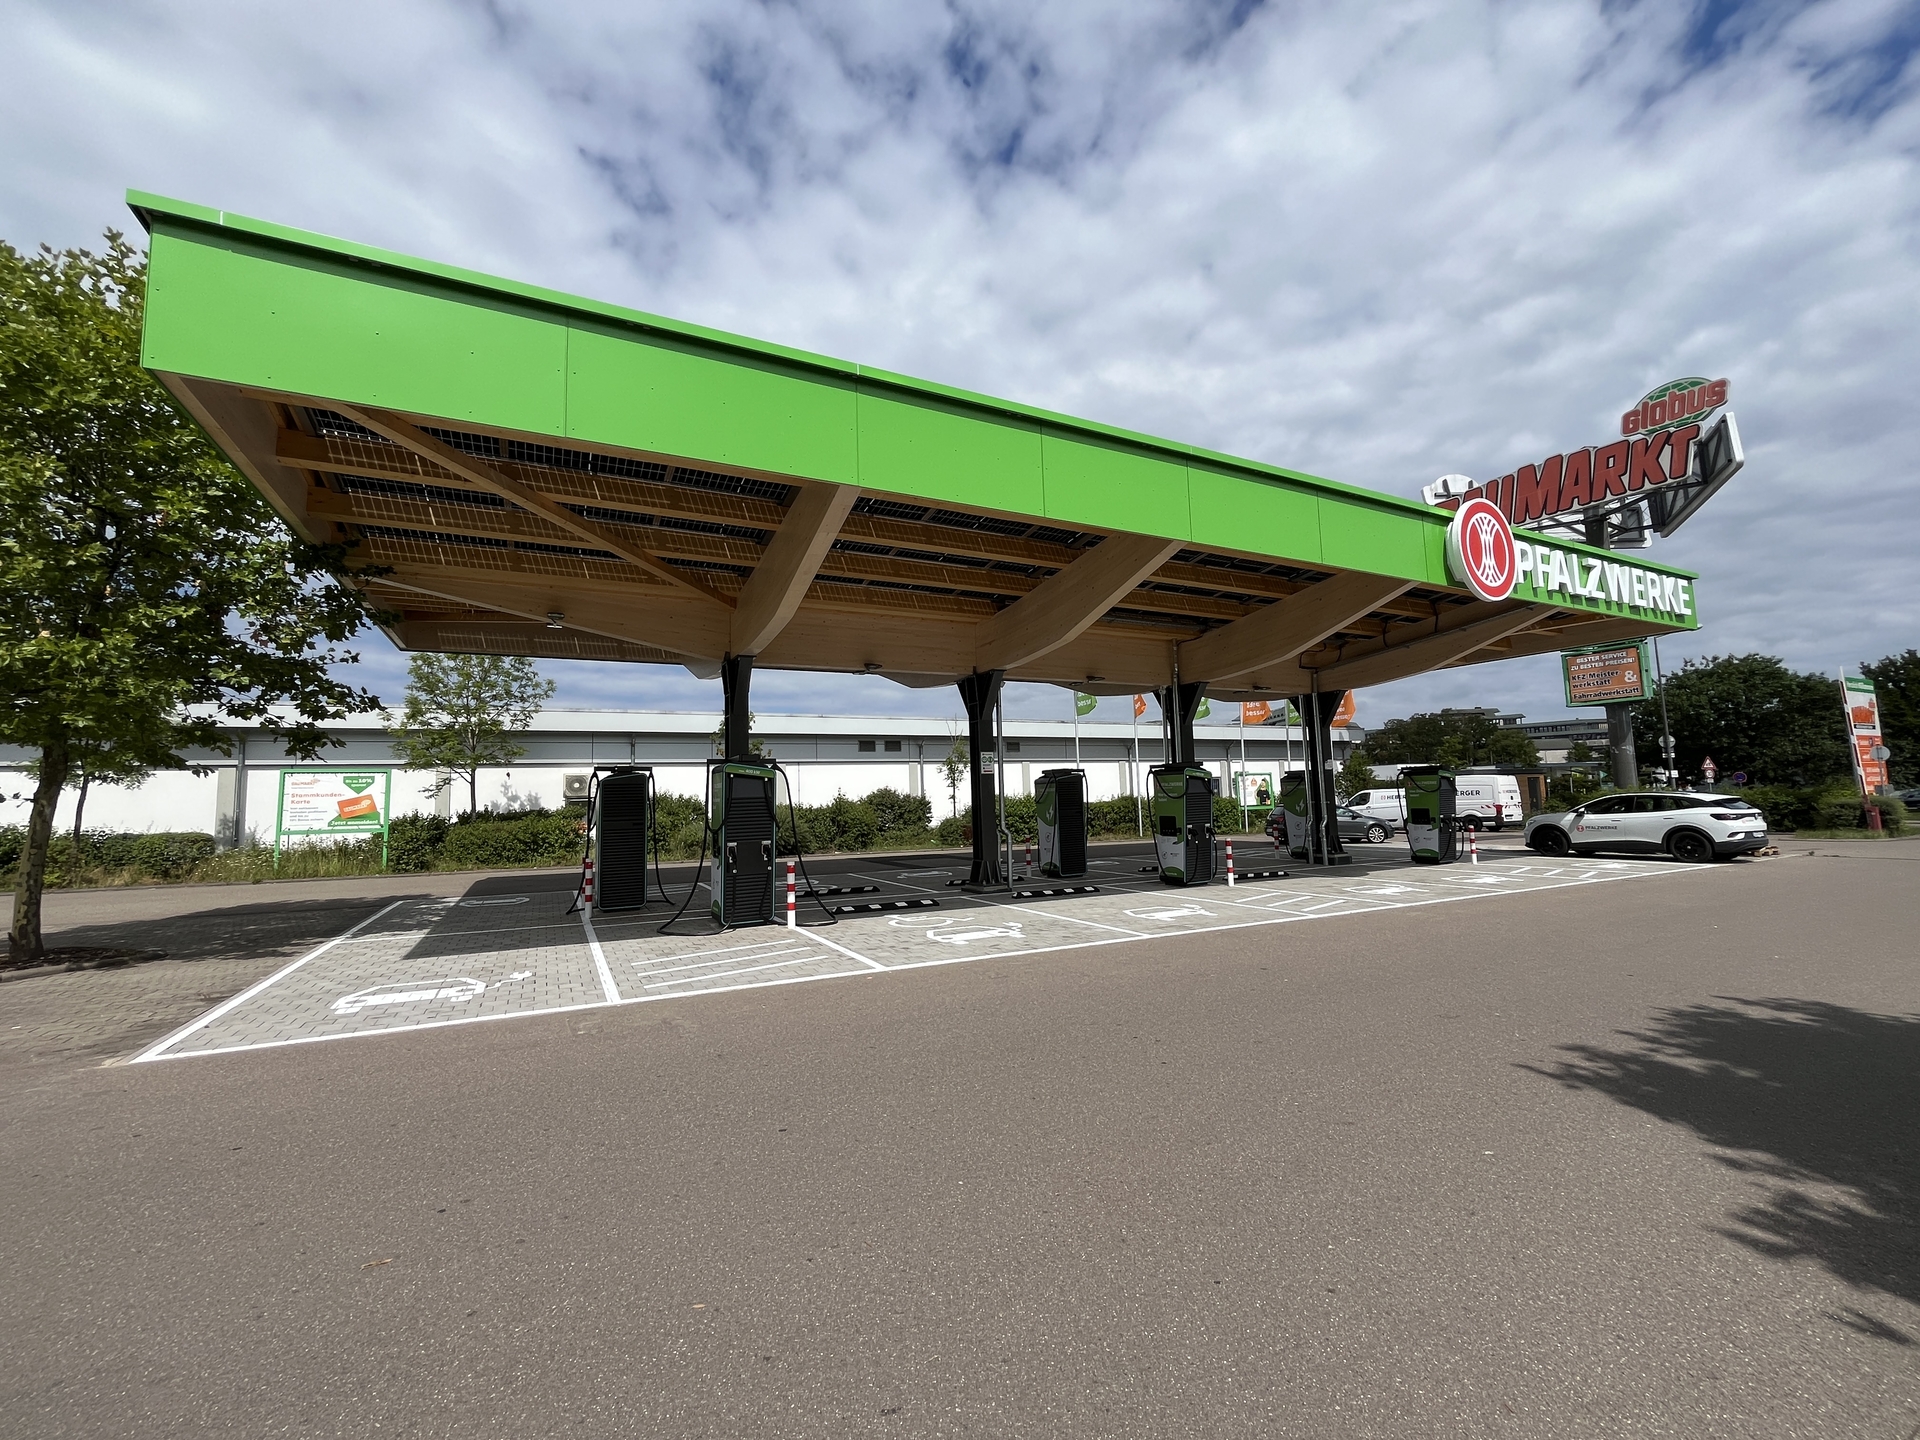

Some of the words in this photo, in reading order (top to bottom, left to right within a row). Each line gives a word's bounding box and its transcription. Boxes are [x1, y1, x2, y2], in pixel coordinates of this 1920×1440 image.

[1434, 424, 1700, 524] UMARKT
[1515, 539, 1692, 616] PFALZWERKE
[1624, 670, 1638, 683] &
[1572, 679, 1611, 688] werkstatt
[1573, 687, 1640, 699] Fahrradwerkstatt
